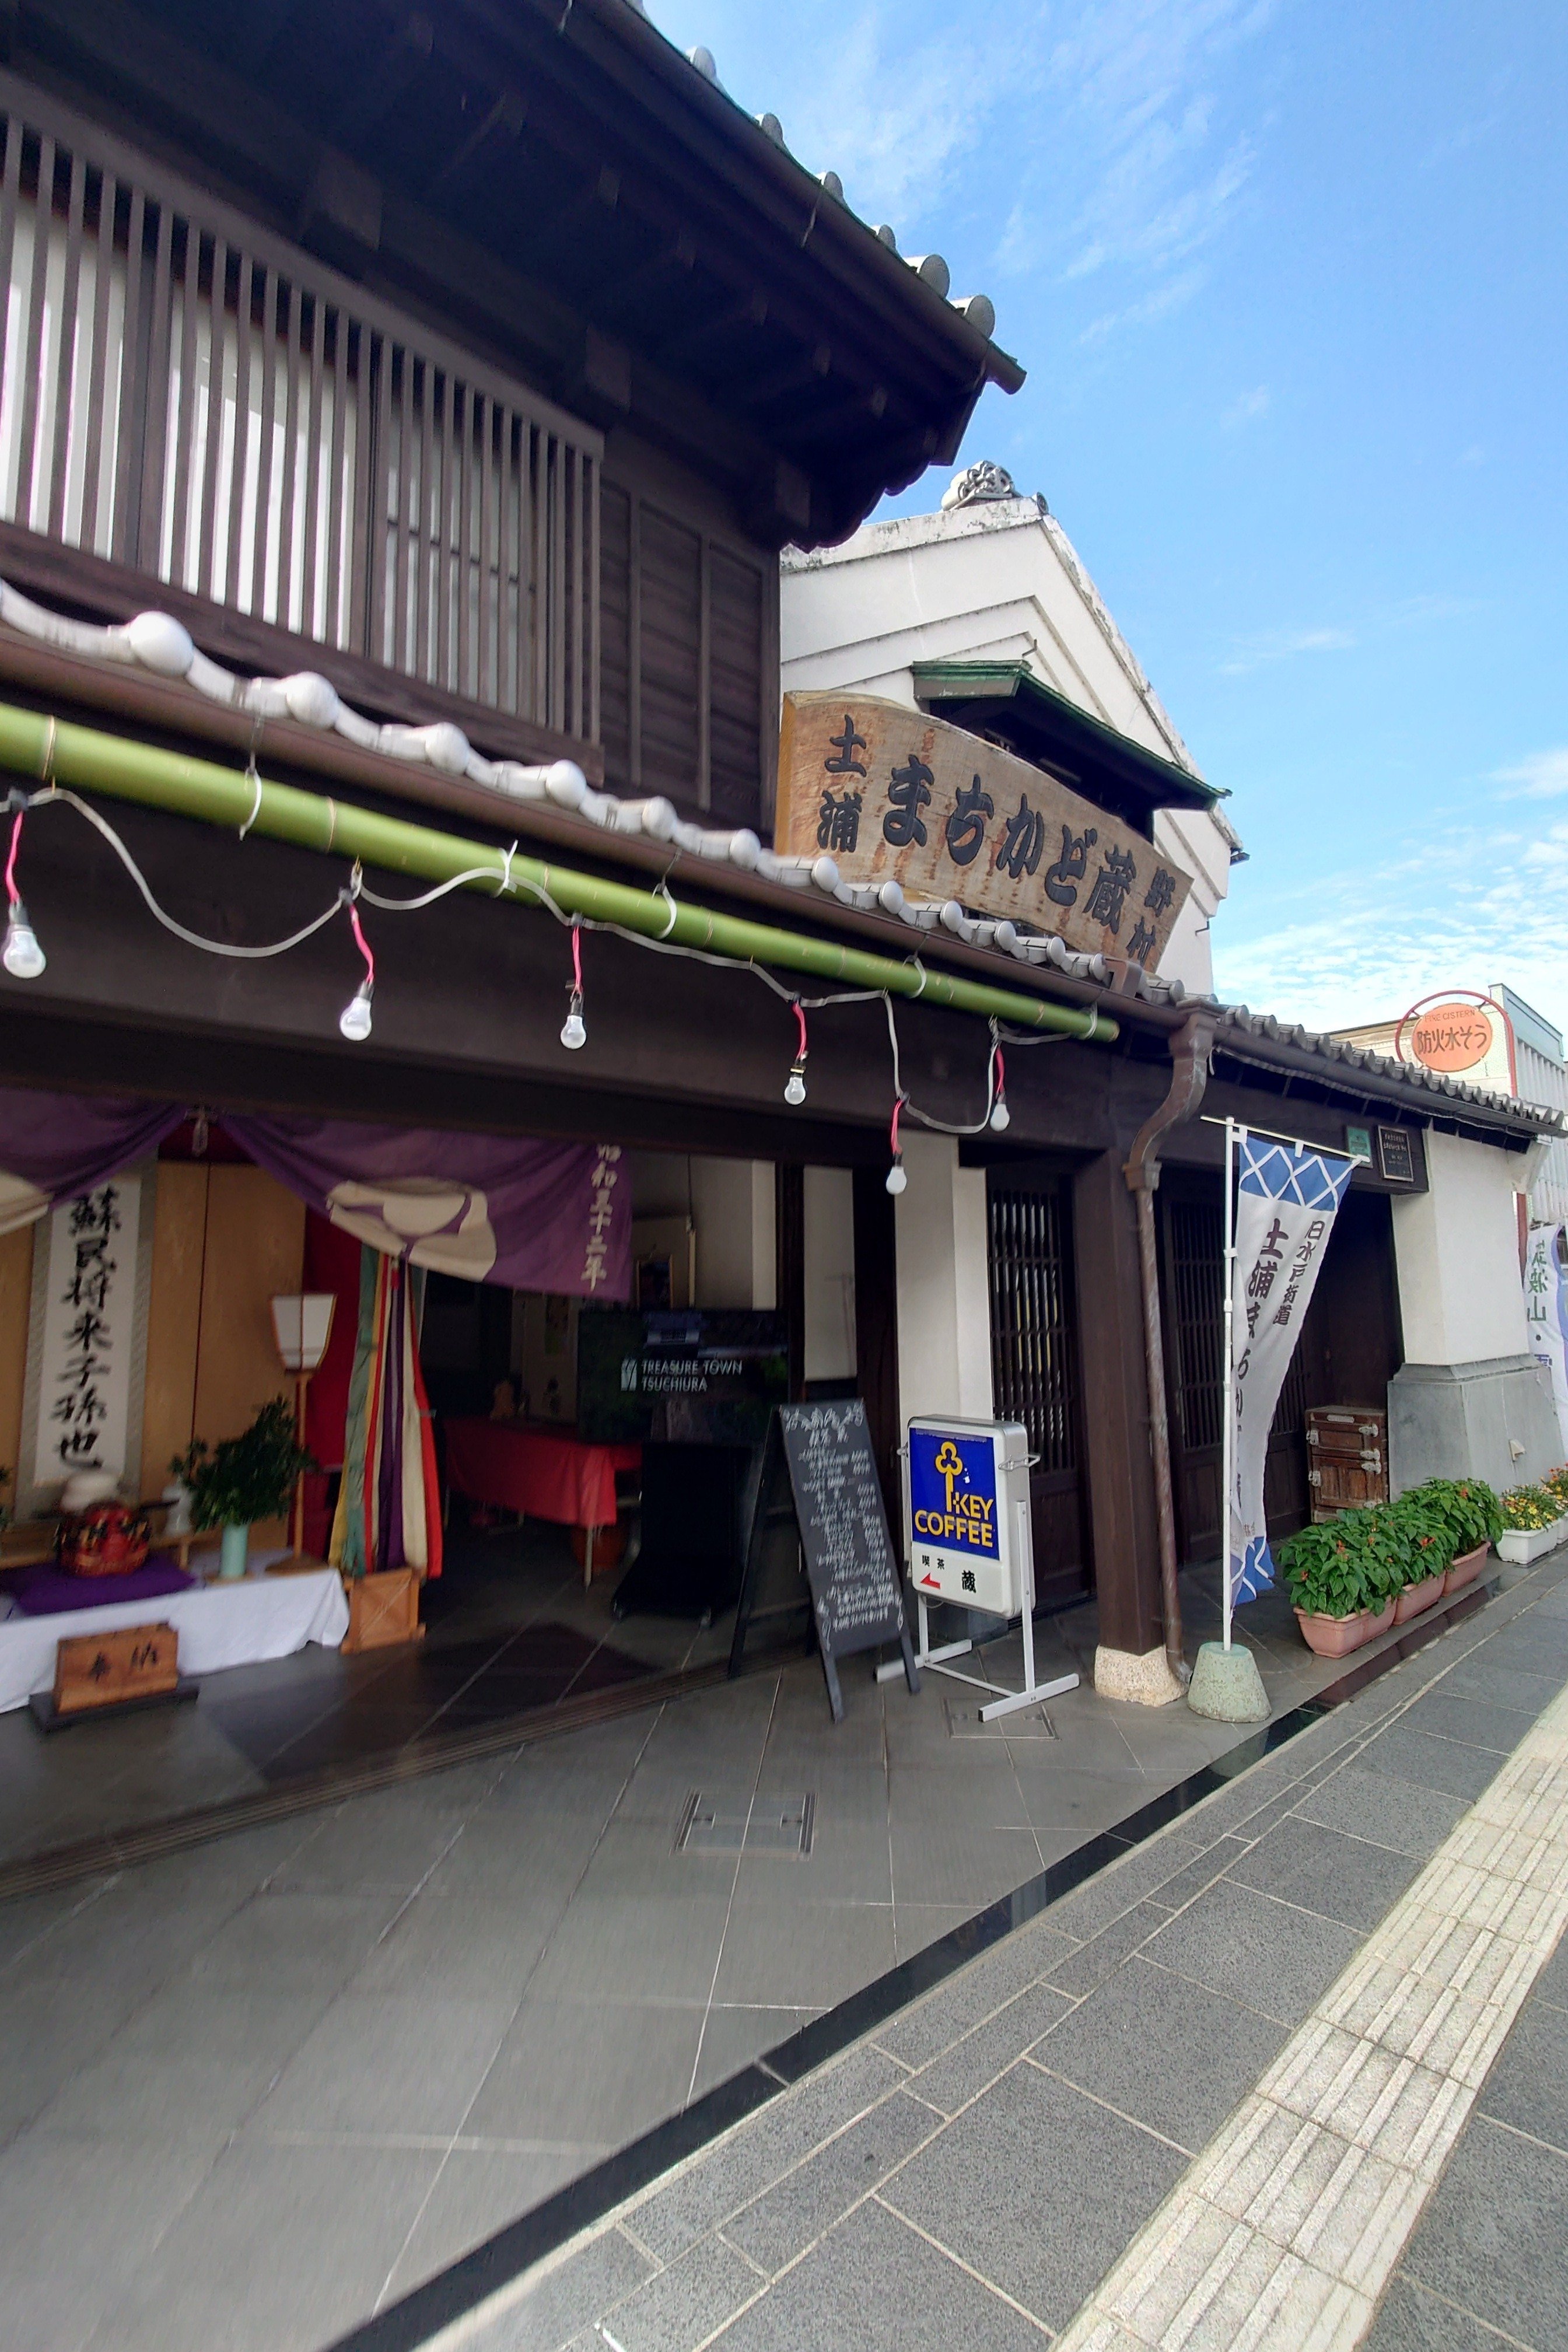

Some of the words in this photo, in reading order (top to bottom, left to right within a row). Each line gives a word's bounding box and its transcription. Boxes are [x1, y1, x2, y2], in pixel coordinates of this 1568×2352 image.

[818, 713, 867, 853] 土浦
[882, 754, 1137, 934] まちかど蔵
[1126, 866, 1174, 966] 野村
[1424, 1014, 1441, 1023] FIRE
[1443, 1009, 1475, 1020] CISTERN
[1416, 1024, 1487, 1055] 防火水そう
[642, 1359, 699, 1375] TREASURE
[702, 1359, 743, 1376] TOWN
[642, 1377, 708, 1392] TSUCHIURA
[953, 1492, 994, 1520] KEY
[914, 1509, 993, 1548] COFFEE
[922, 1554, 945, 1570] 喫茶
